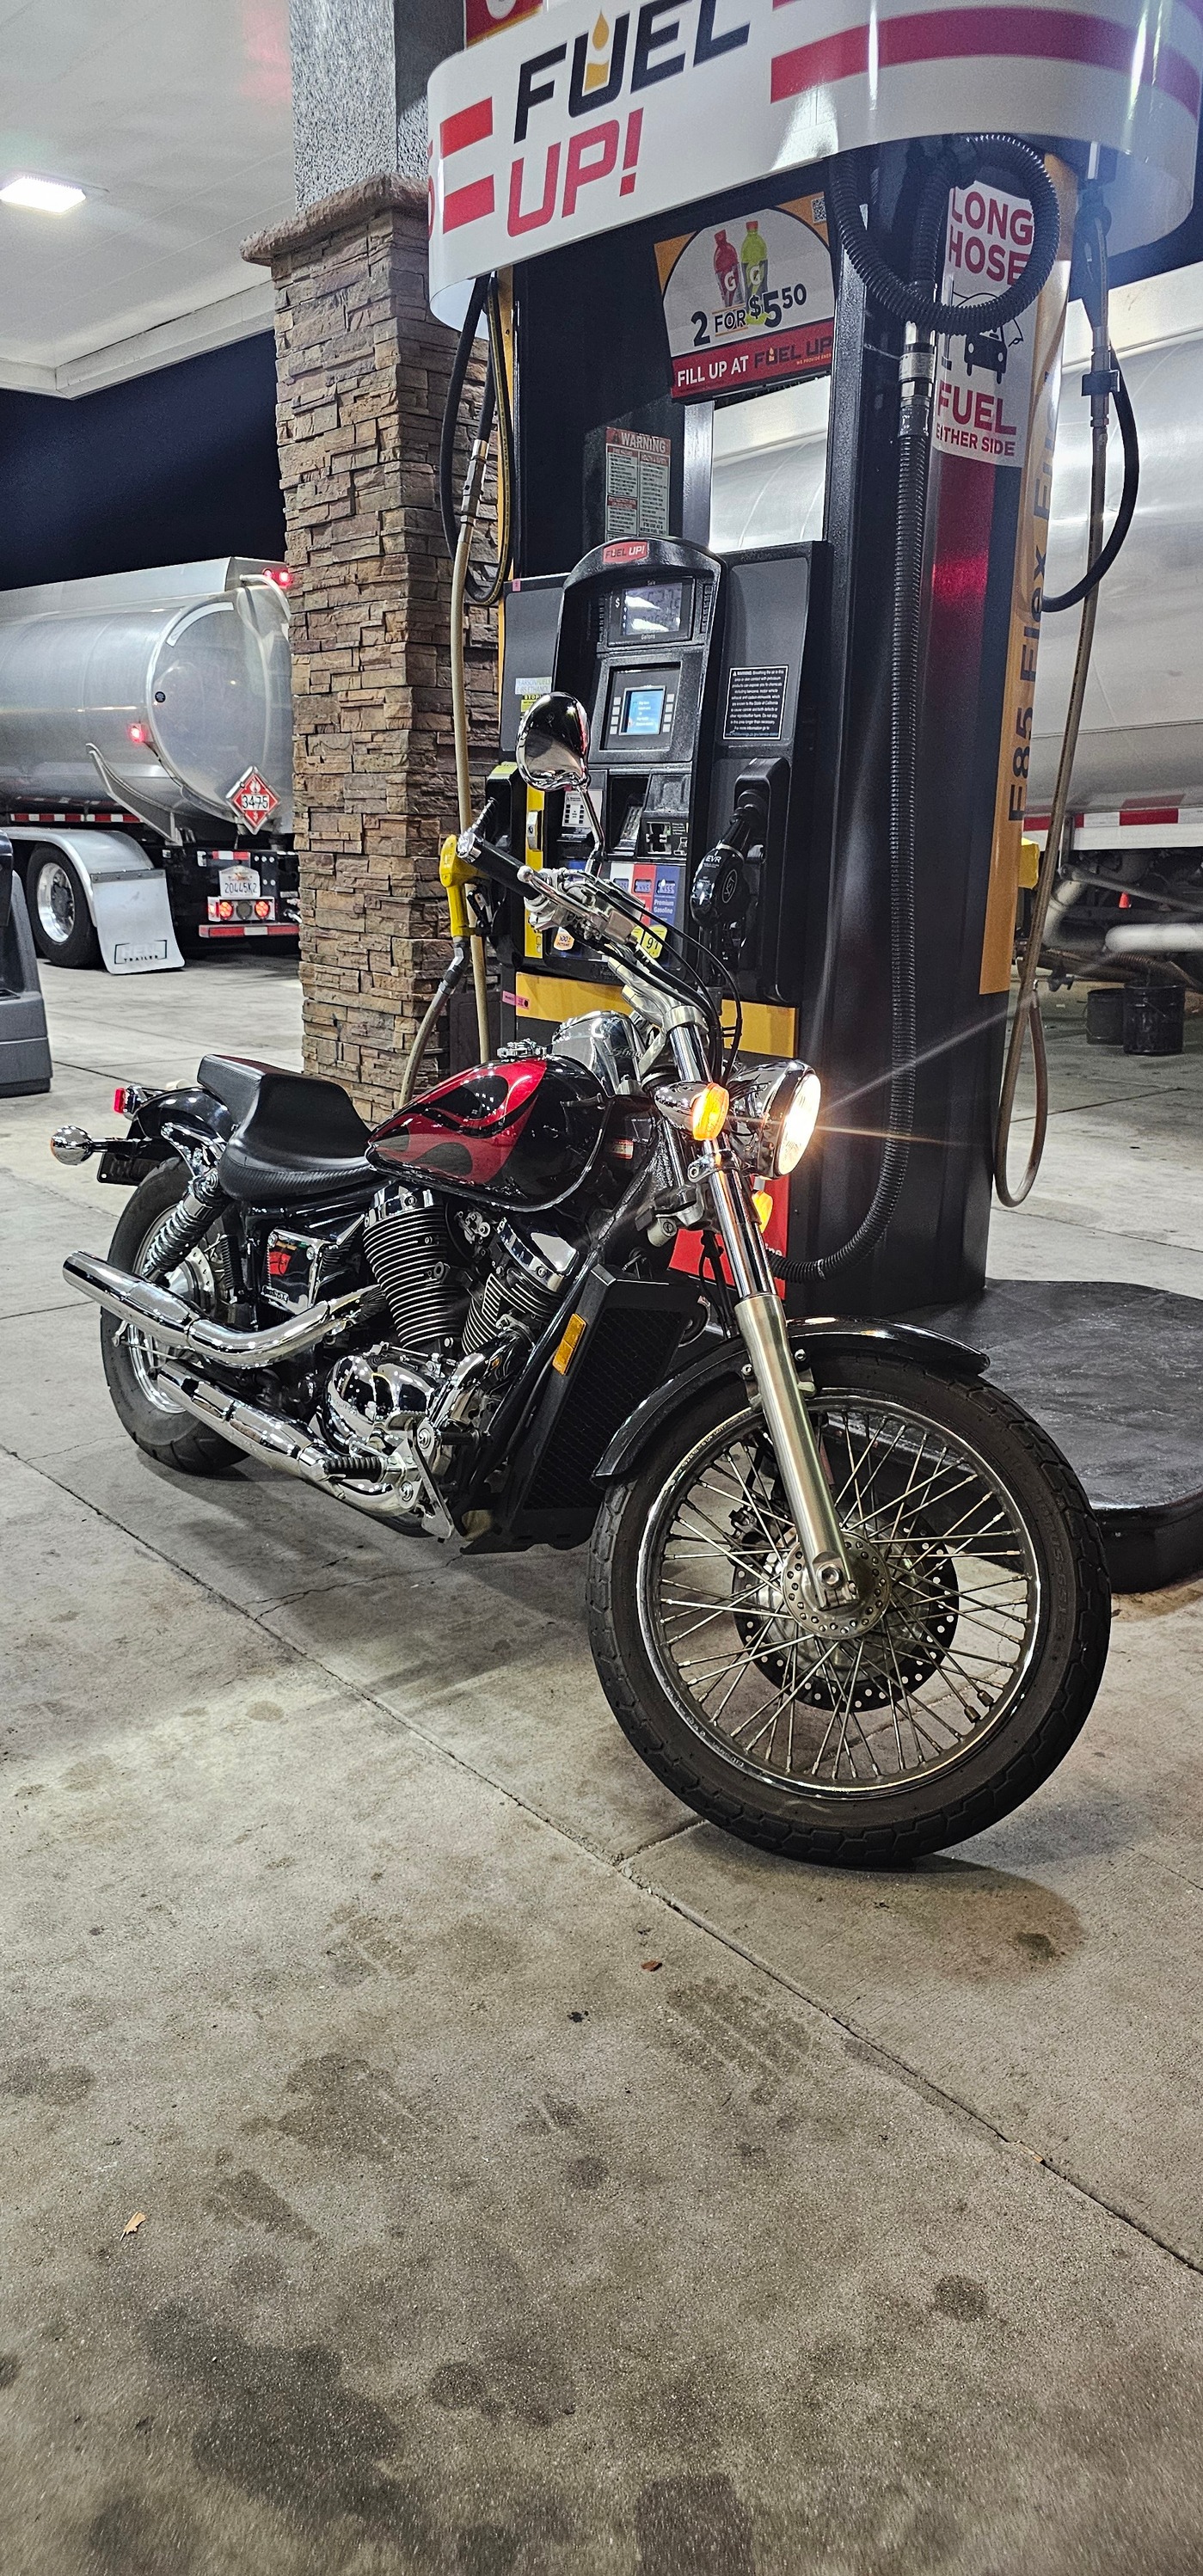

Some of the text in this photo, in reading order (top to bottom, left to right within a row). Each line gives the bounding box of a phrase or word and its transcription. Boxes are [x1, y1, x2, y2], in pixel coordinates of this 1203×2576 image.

[513, 0, 751, 144] FUEL
[507, 107, 644, 237] UP!
[951, 187, 1034, 247] LONG
[948, 224, 1032, 285] HOSE
[690, 310, 711, 347] 2
[715, 309, 746, 333] FOR
[678, 367, 705, 387] FILL
[709, 360, 727, 379] UP
[731, 355, 749, 375] AT
[754, 343, 801, 369] FUEL
[937, 378, 1016, 435] FUEL
[621, 431, 666, 453] WARNING
[936, 422, 1016, 457] EITHER SIDE
[605, 545, 645, 559] FUEL UP!
[615, 597, 620, 608] $
[242, 795, 268, 809] 3475
[705, 855, 722, 863] EVR
[646, 937, 659, 950] 91
